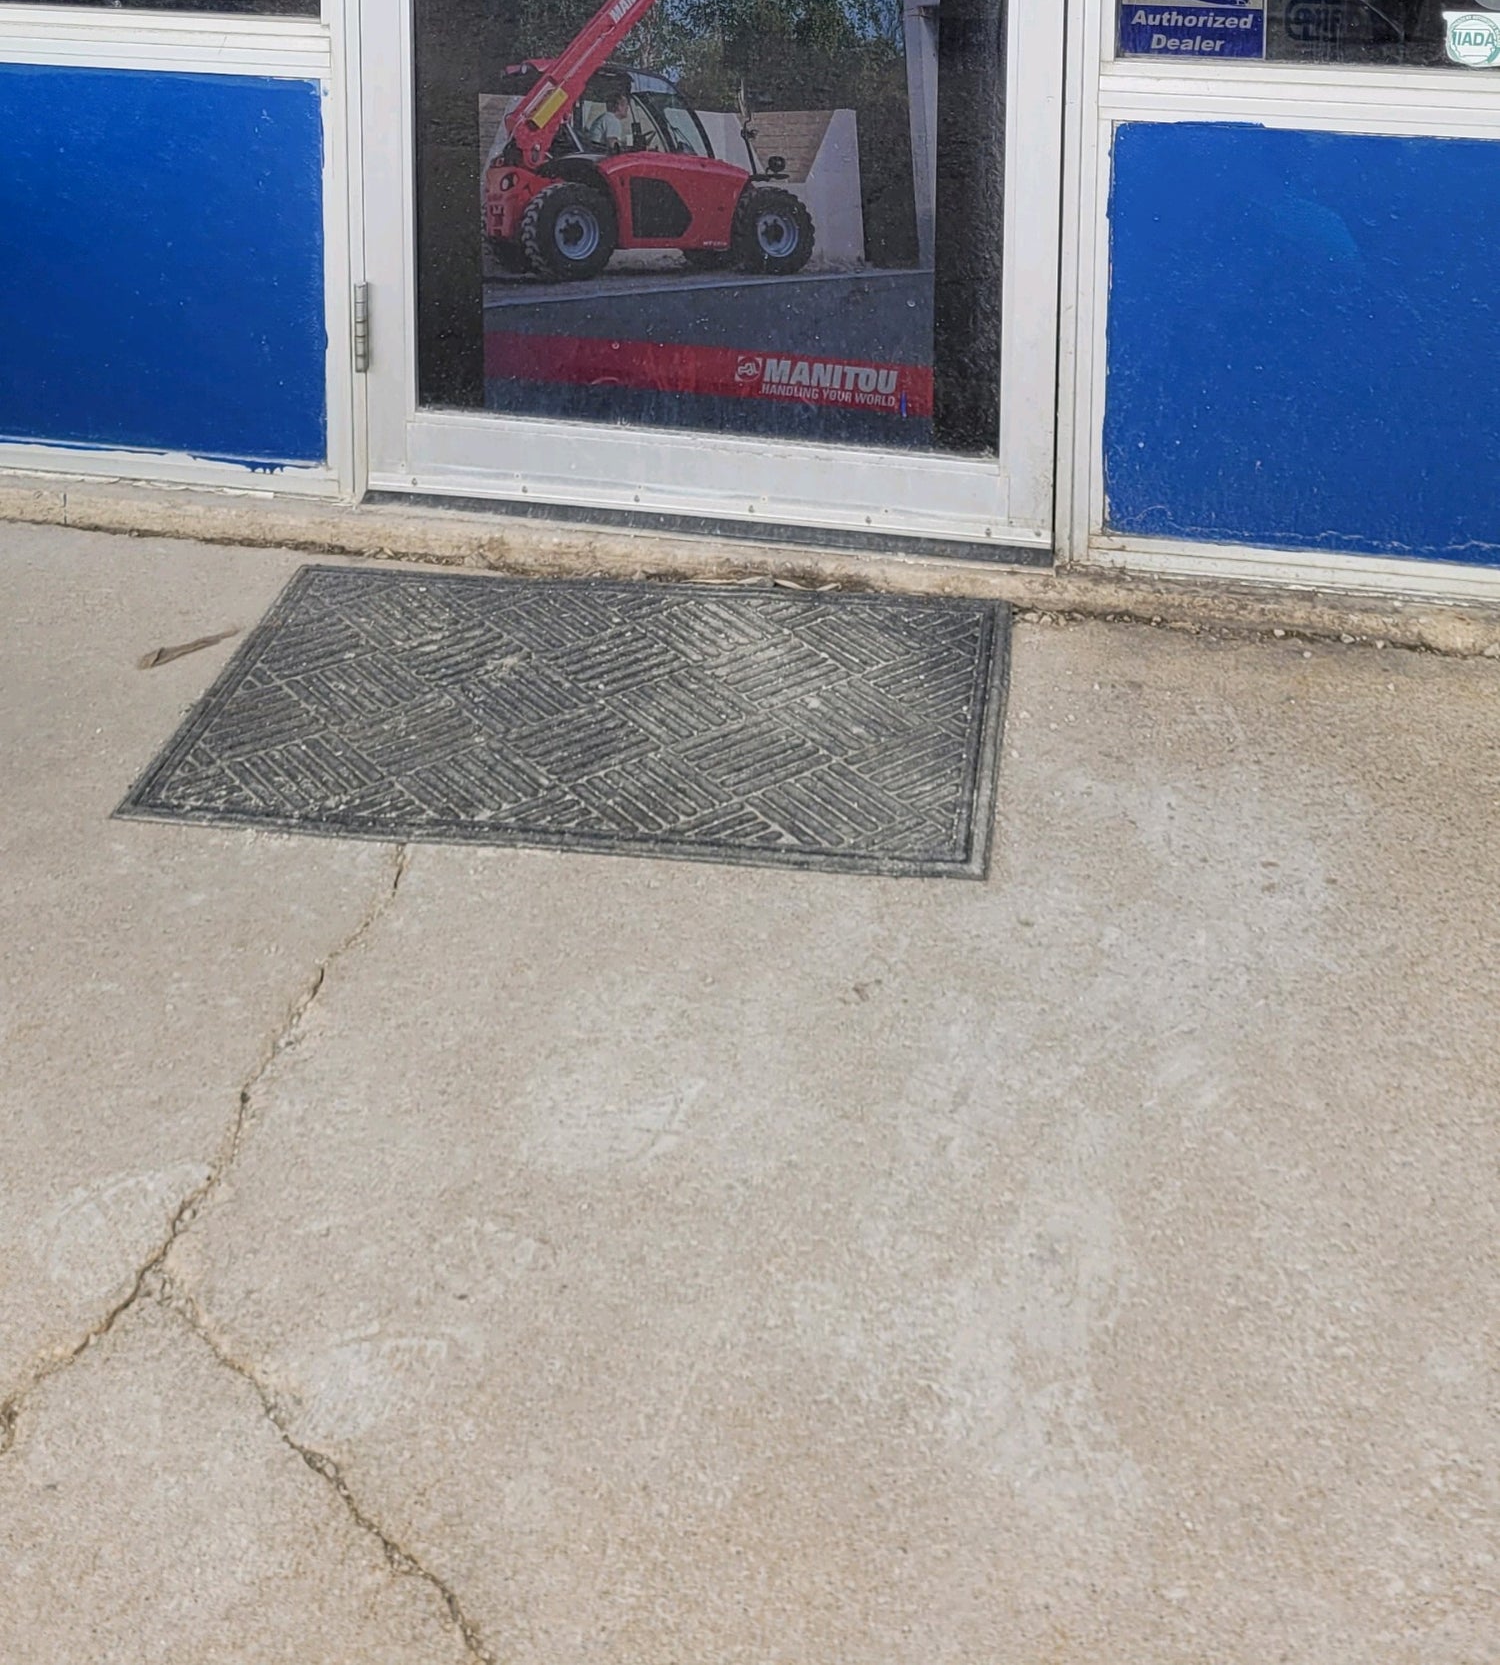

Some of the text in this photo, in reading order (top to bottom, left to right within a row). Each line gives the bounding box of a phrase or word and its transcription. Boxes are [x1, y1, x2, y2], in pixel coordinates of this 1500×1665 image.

[1131, 10, 1254, 29] Authorized
[1151, 34, 1225, 52] Dealer
[763, 358, 898, 394] MANITOU
[761, 384, 896, 408] HANDLING YOUR WORLD
